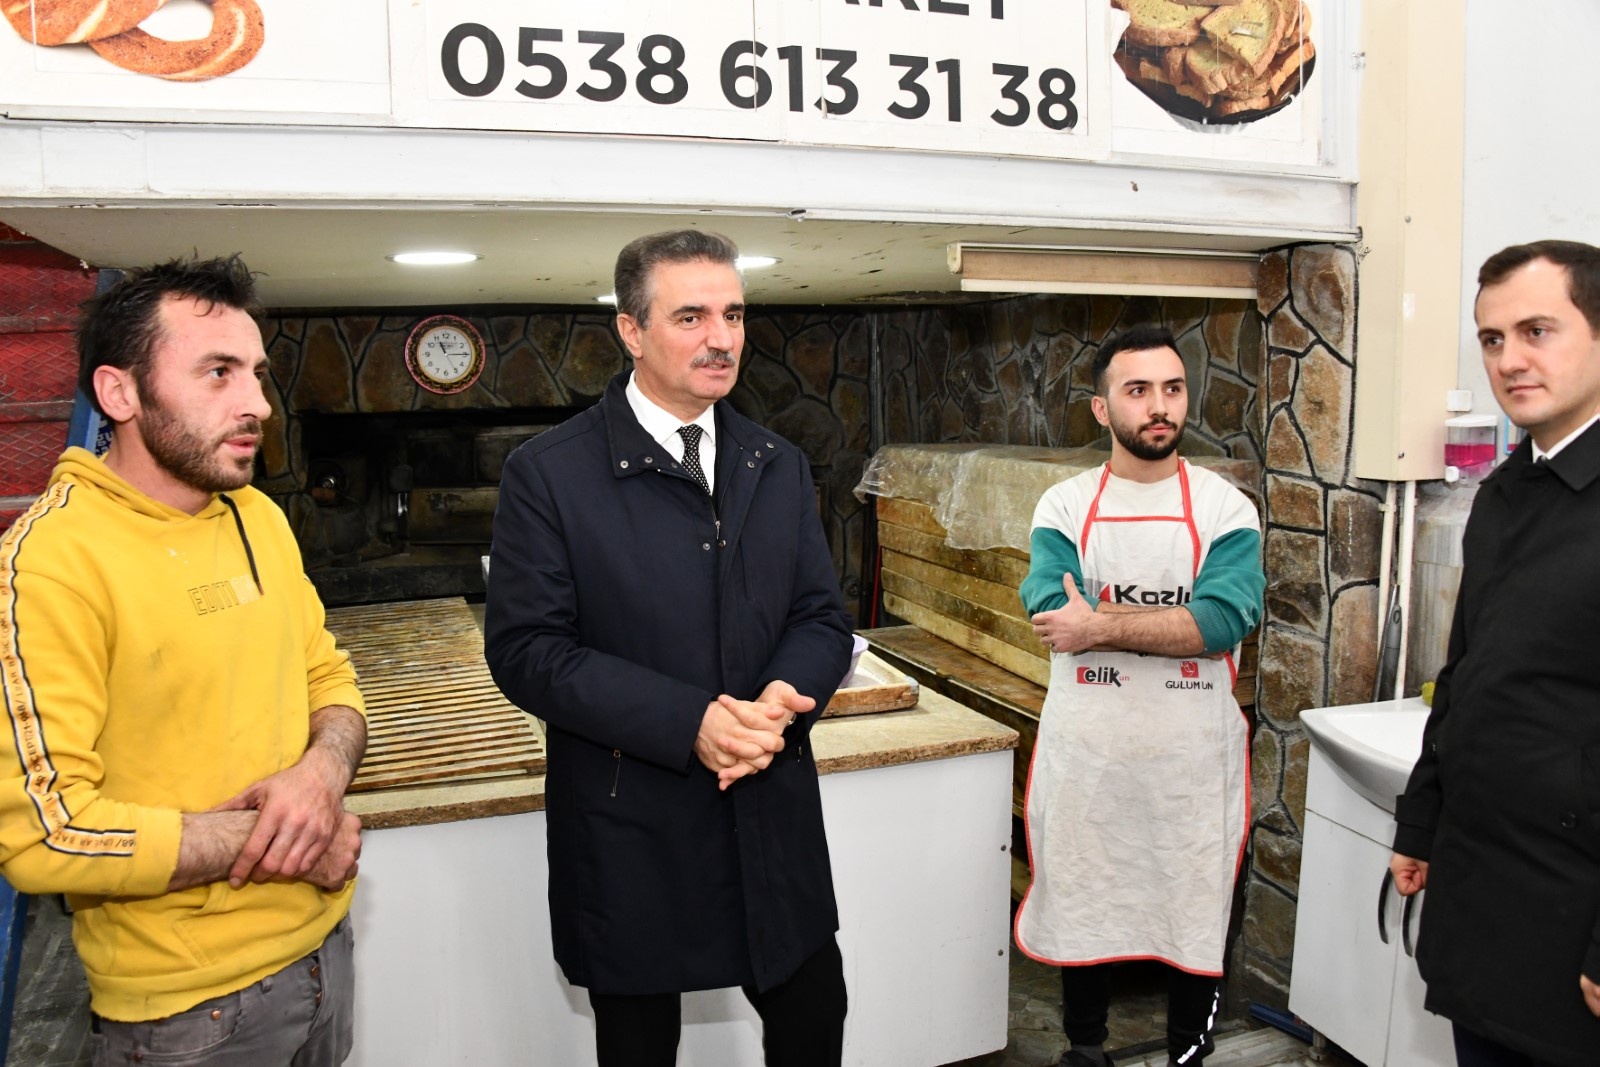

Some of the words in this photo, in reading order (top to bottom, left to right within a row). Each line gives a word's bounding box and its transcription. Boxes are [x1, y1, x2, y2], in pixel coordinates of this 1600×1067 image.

[441, 22, 689, 105] 0538
[719, 40, 859, 117] 613
[887, 53, 962, 123] 31
[990, 63, 1079, 131] 38
